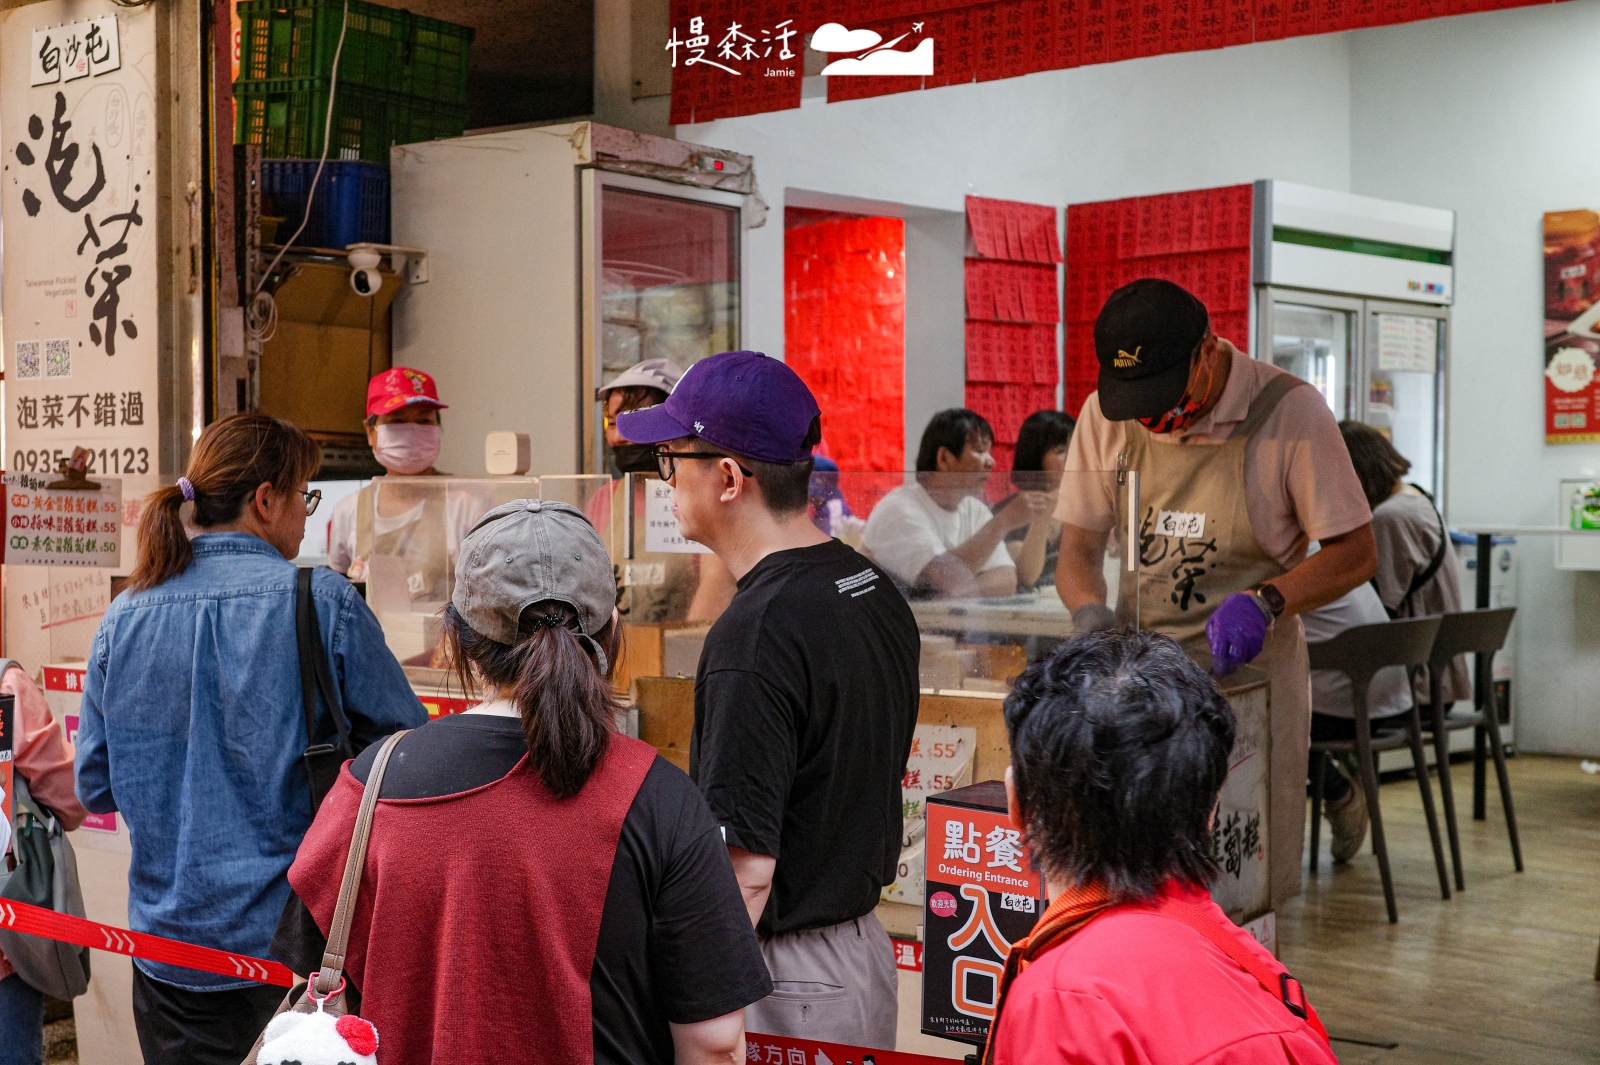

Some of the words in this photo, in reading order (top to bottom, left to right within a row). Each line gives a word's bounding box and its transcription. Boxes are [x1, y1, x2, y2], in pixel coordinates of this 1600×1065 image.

[38, 23, 110, 73] 白沙屯
[15, 91, 143, 357] 泡菜
[55, 275, 77, 284] Pickled
[44, 288, 77, 298] Vegetables
[16, 391, 145, 429] 泡菜不錯過
[1163, 515, 1200, 535] 白沙屯
[927, 743, 955, 759] $55
[943, 819, 1024, 872] 點餐
[938, 863, 983, 882] Ordering
[984, 871, 1029, 888] Entrance
[1004, 895, 1033, 911] 白沙屯
[947, 883, 1013, 1020] 入口
